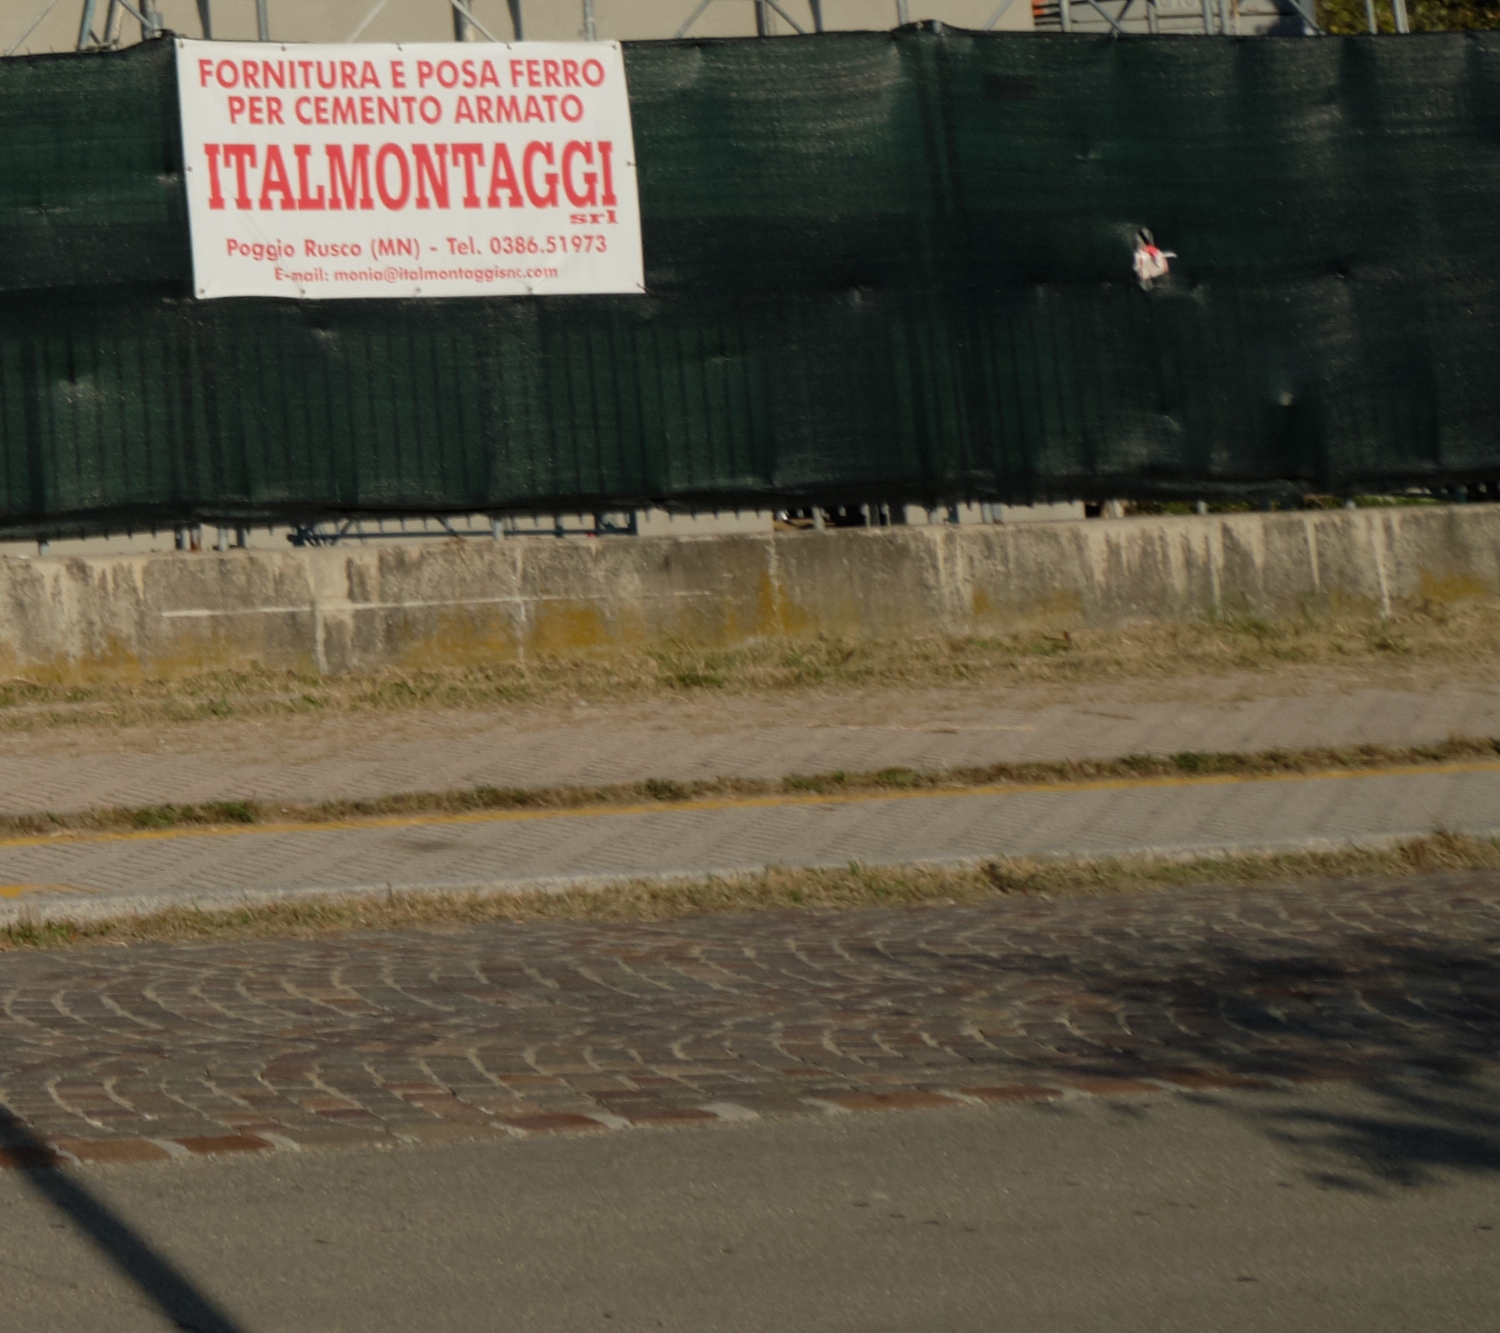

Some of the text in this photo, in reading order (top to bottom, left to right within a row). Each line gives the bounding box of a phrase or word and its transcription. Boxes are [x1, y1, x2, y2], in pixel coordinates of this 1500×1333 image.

[198, 58, 605, 89] FORNITURA E POSA FERRO
[228, 94, 585, 125] PER CEMENTO ARMATO
[204, 140, 618, 211] ITALMONTAGGI
[569, 210, 619, 225] srl
[227, 237, 295, 261] Poggio
[304, 239, 362, 258] Rusco
[371, 238, 420, 260] (MN)
[447, 236, 482, 256] Tel.
[489, 235, 607, 256] 0386.51973
[274, 264, 558, 284] E-mail: monia@italmontaggisnc.com
